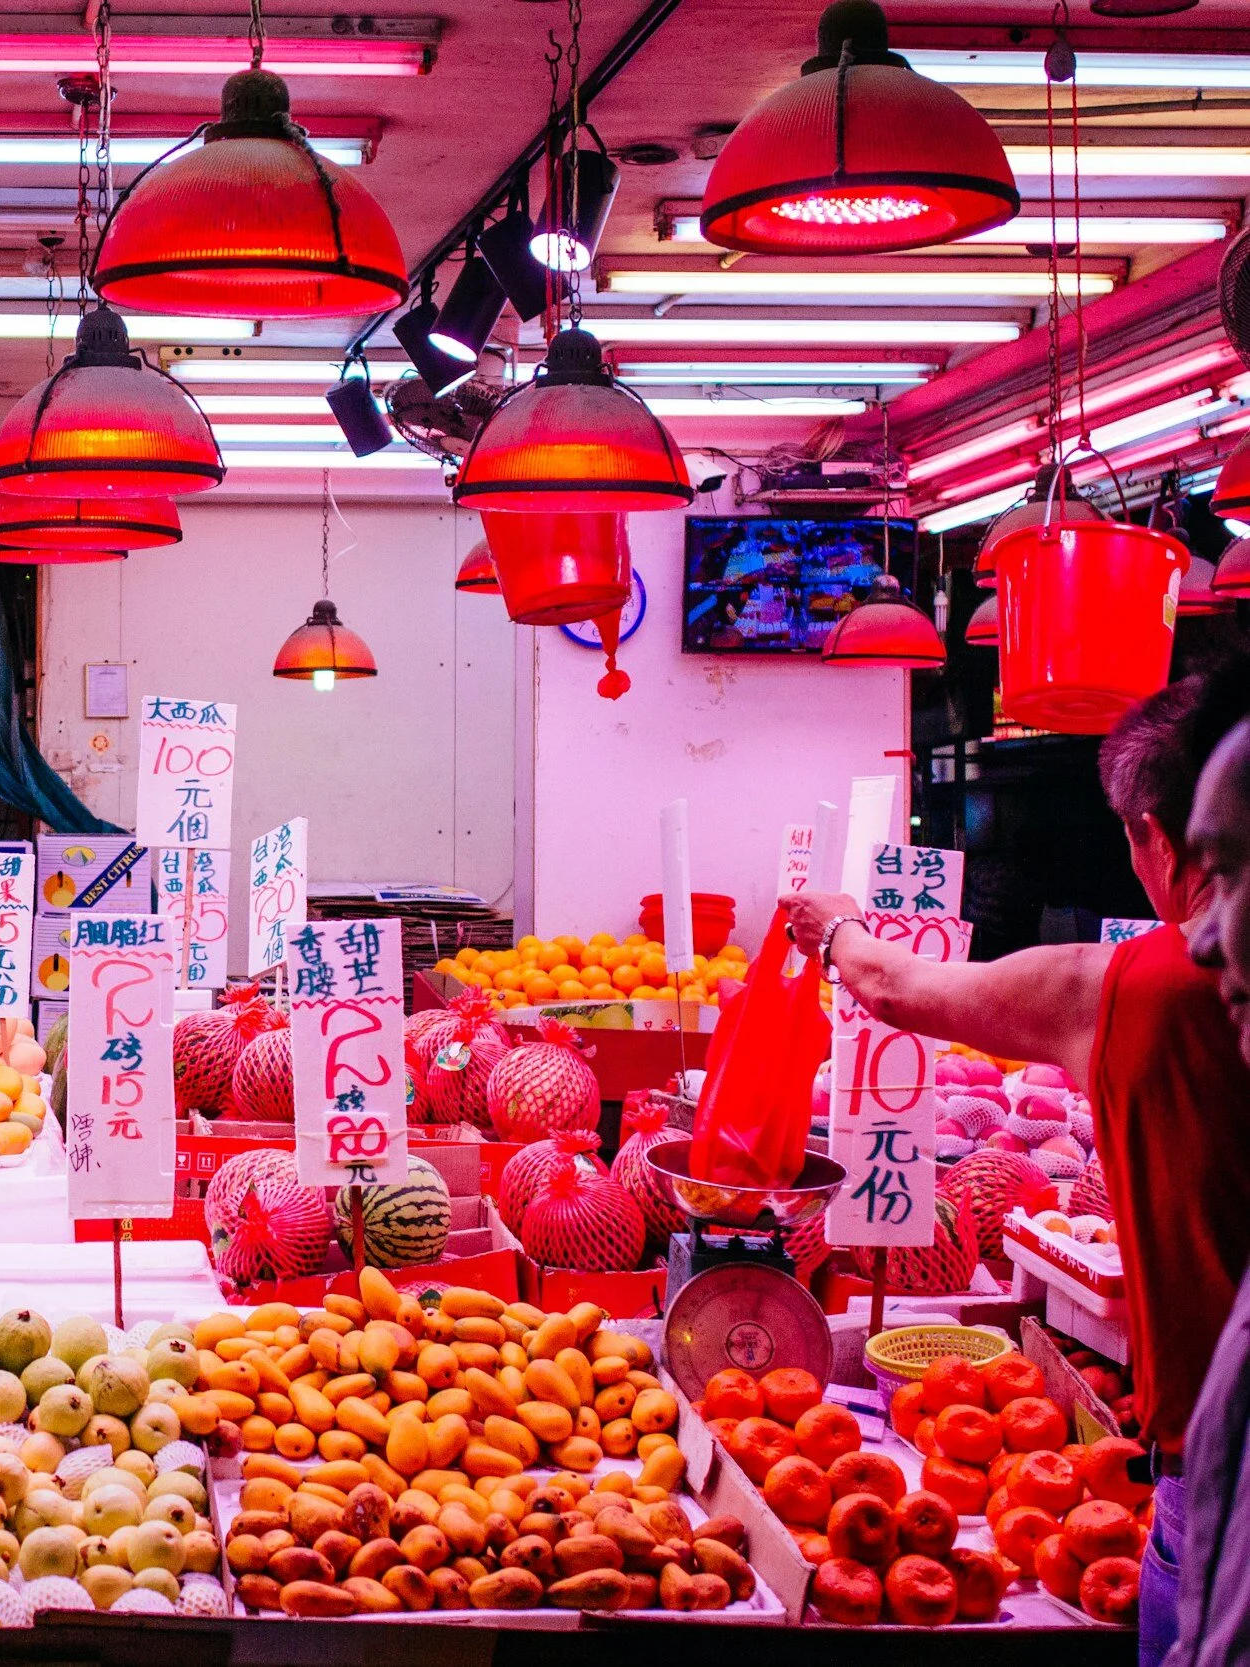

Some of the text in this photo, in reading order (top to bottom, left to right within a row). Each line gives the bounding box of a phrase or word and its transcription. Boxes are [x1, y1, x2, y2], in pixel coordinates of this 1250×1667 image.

[148, 697, 227, 726] 大西瓜
[153, 737, 232, 776] 100
[83, 845, 144, 905] BEST CITRUS
[168, 898, 228, 942] 35
[871, 886, 946, 914] 西瓜
[289, 922, 385, 966] 香甜
[92, 959, 154, 1036] 2
[321, 1002, 392, 1100] 2
[849, 1028, 926, 1115] 10
[102, 1071, 143, 1107] 15
[106, 1111, 142, 1140] 元
[344, 1159, 378, 1183] 元
